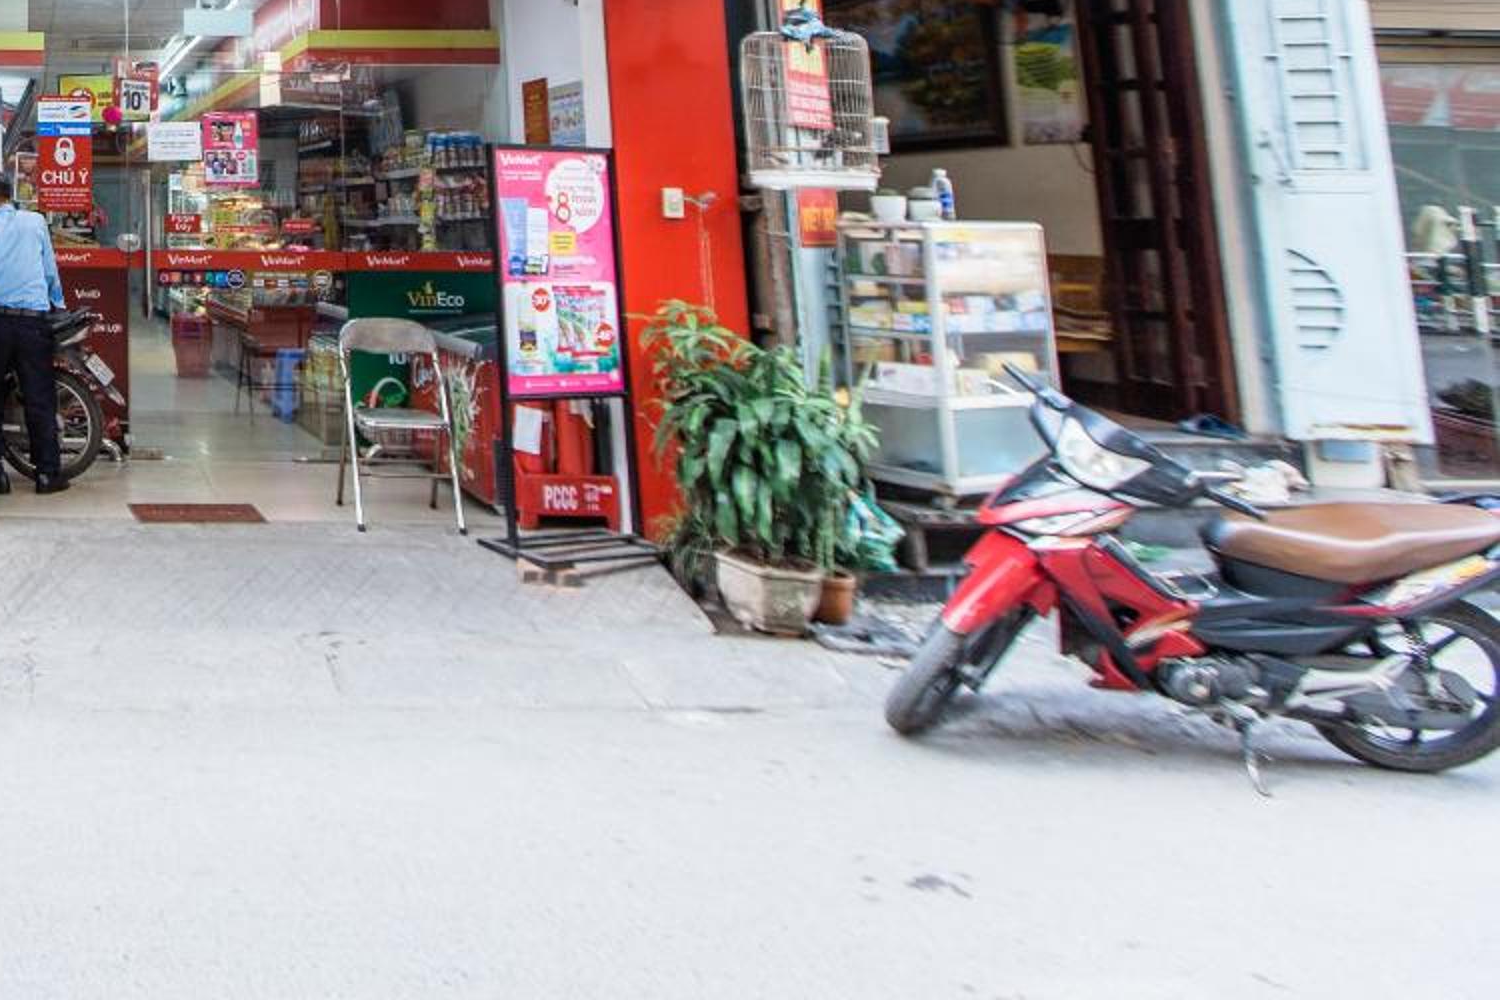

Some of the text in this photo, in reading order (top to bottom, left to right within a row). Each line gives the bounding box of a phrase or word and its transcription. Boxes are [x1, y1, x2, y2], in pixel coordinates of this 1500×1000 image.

[41, 166, 90, 185] CHÚ Ý
[543, 484, 578, 511] PCCC
